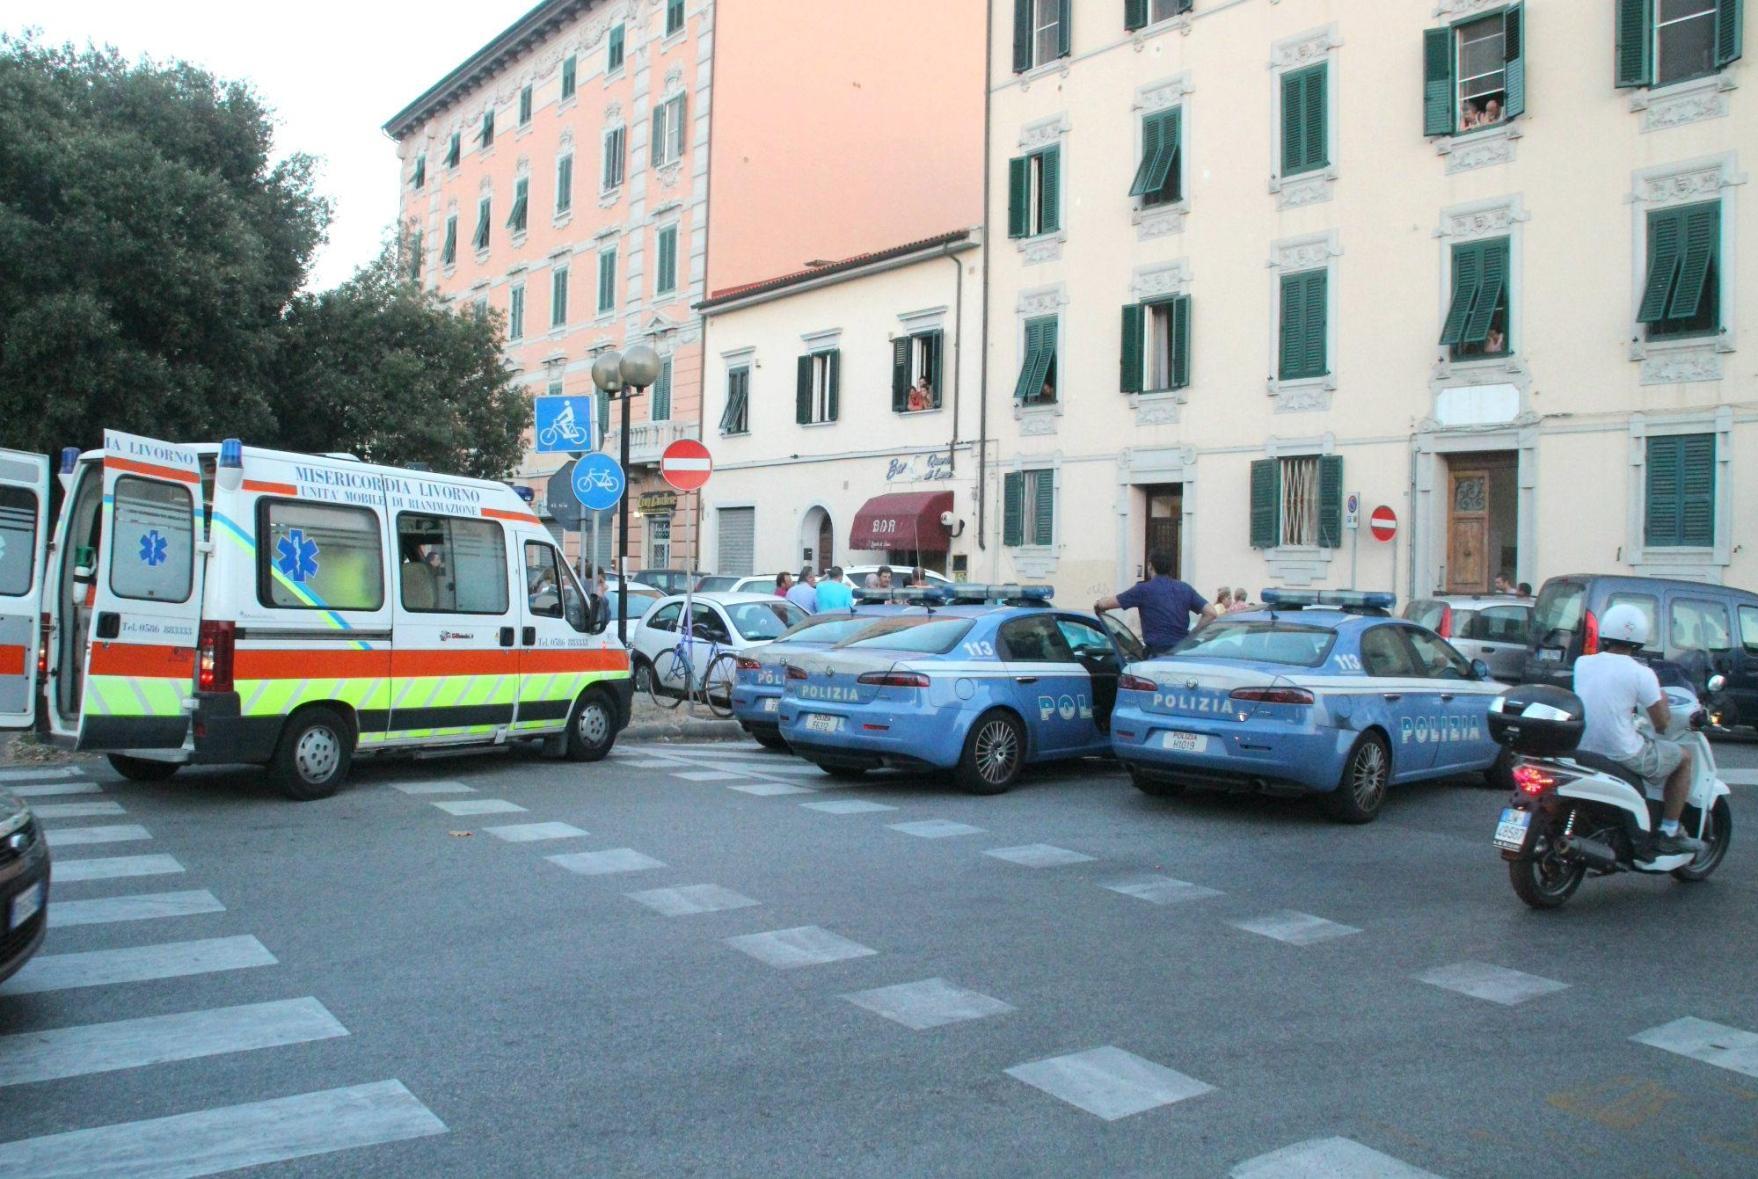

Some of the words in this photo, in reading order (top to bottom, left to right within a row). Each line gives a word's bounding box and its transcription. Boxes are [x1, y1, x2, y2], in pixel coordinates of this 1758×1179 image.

[105, 436, 121, 450] IA
[130, 442, 194, 465] LIVORNO
[887, 458, 907, 480] Bar
[295, 466, 412, 494] MISERICORDIA
[419, 482, 480, 503] LIVORNO
[345, 490, 387, 505] MOBILE
[392, 496, 404, 506] DI
[408, 499, 477, 516] RIANIMAZIONE
[872, 519, 896, 533] BAR
[963, 640, 994, 657] 113
[1334, 653, 1361, 671] 113
[802, 685, 859, 701] POLIZIA
[1153, 693, 1233, 714] POLIZIA
[1038, 694, 1093, 721] POL
[1173, 731, 1198, 741] POLIZIA
[1401, 715, 1481, 744] POLIZIA
